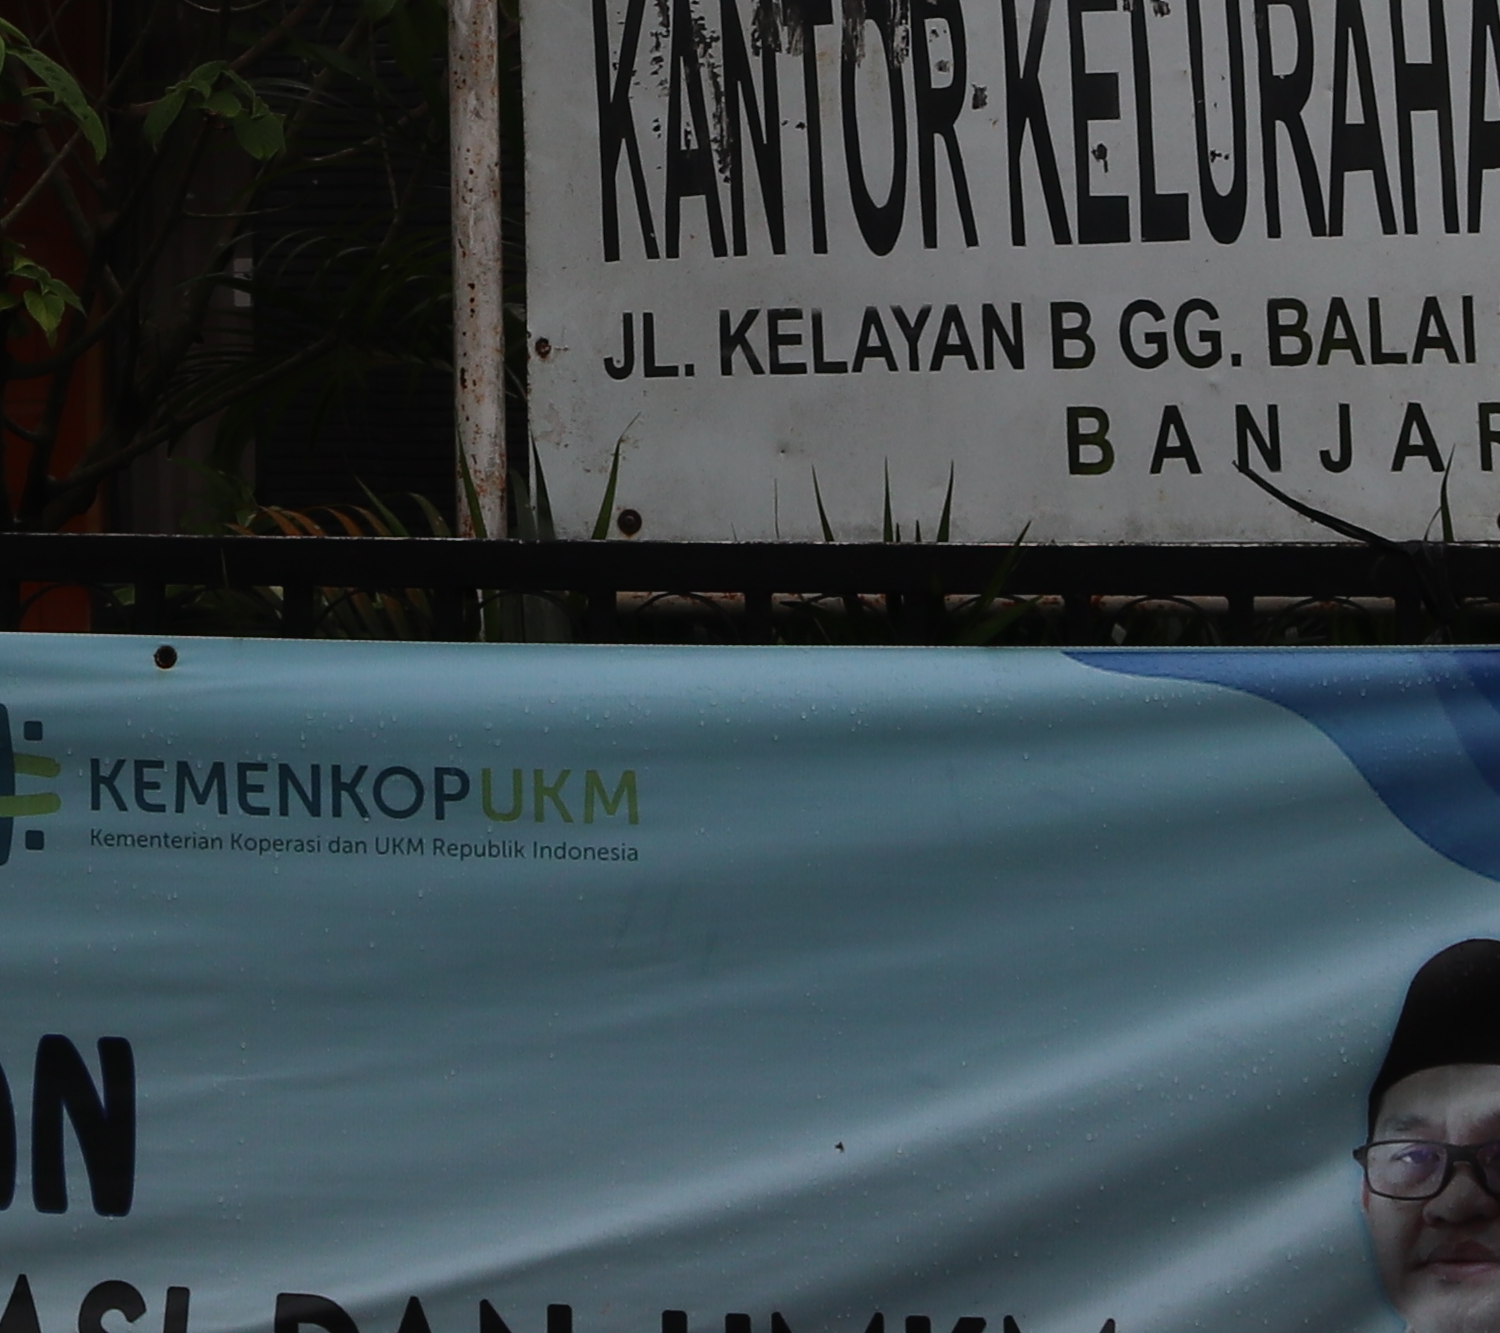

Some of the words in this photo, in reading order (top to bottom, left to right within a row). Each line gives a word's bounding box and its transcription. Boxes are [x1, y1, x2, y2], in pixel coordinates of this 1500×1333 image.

[603, 311, 697, 379] JL.
[718, 302, 1025, 376] KELAYAN
[1049, 300, 1096, 369] B
[1118, 297, 1243, 369] GG.
[1266, 294, 1477, 366] BALAI
[90, 829, 224, 852] Kementerian
[230, 833, 322, 858] Koperasi
[328, 837, 368, 854] dan
[375, 838, 425, 856] UKM
[432, 839, 526, 863] Republik
[533, 841, 639, 862] Indonesia
